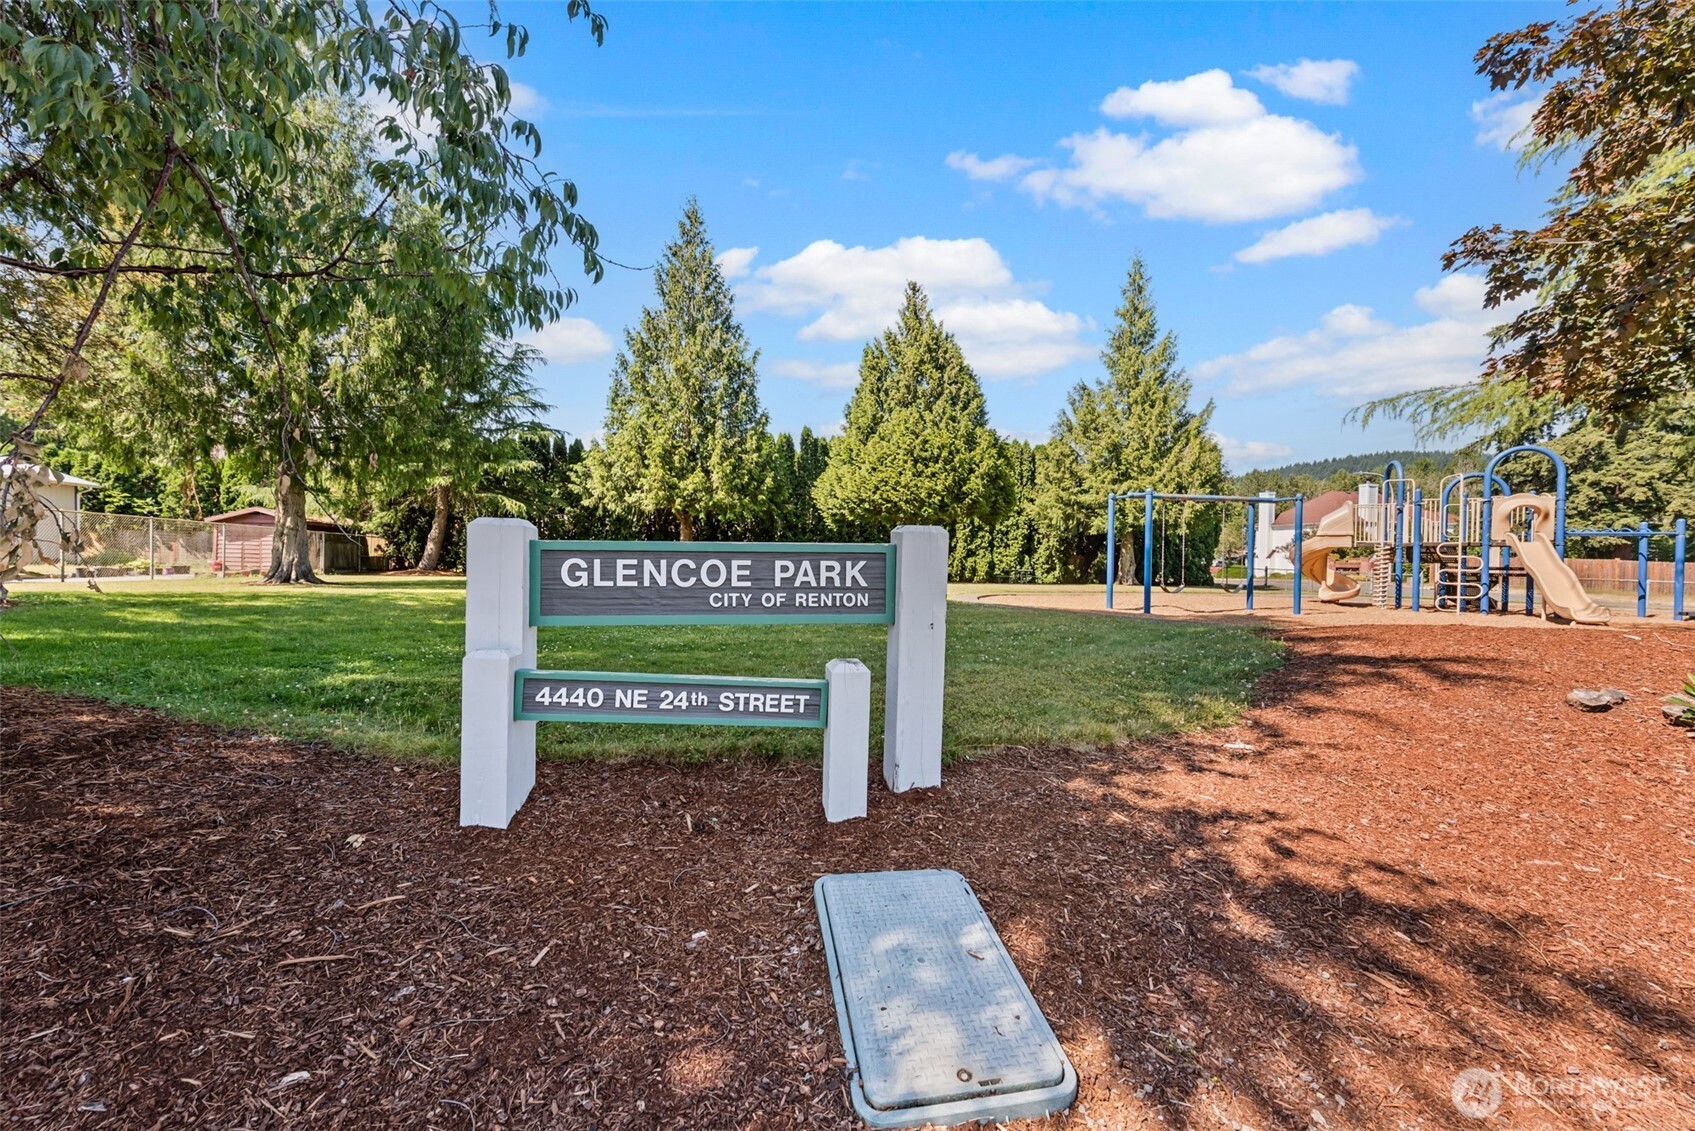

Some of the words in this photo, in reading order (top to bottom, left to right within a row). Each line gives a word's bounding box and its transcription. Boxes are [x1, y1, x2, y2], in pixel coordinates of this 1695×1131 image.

[560, 558, 752, 588] GLENCOE
[774, 560, 868, 587] PARK
[709, 592, 752, 607] CITY
[761, 592, 787, 607] OF
[795, 592, 869, 607] RENTON
[535, 686, 604, 708] 4440
[615, 690, 648, 709] NE
[659, 690, 708, 710] 24th
[719, 692, 810, 713] STREET
